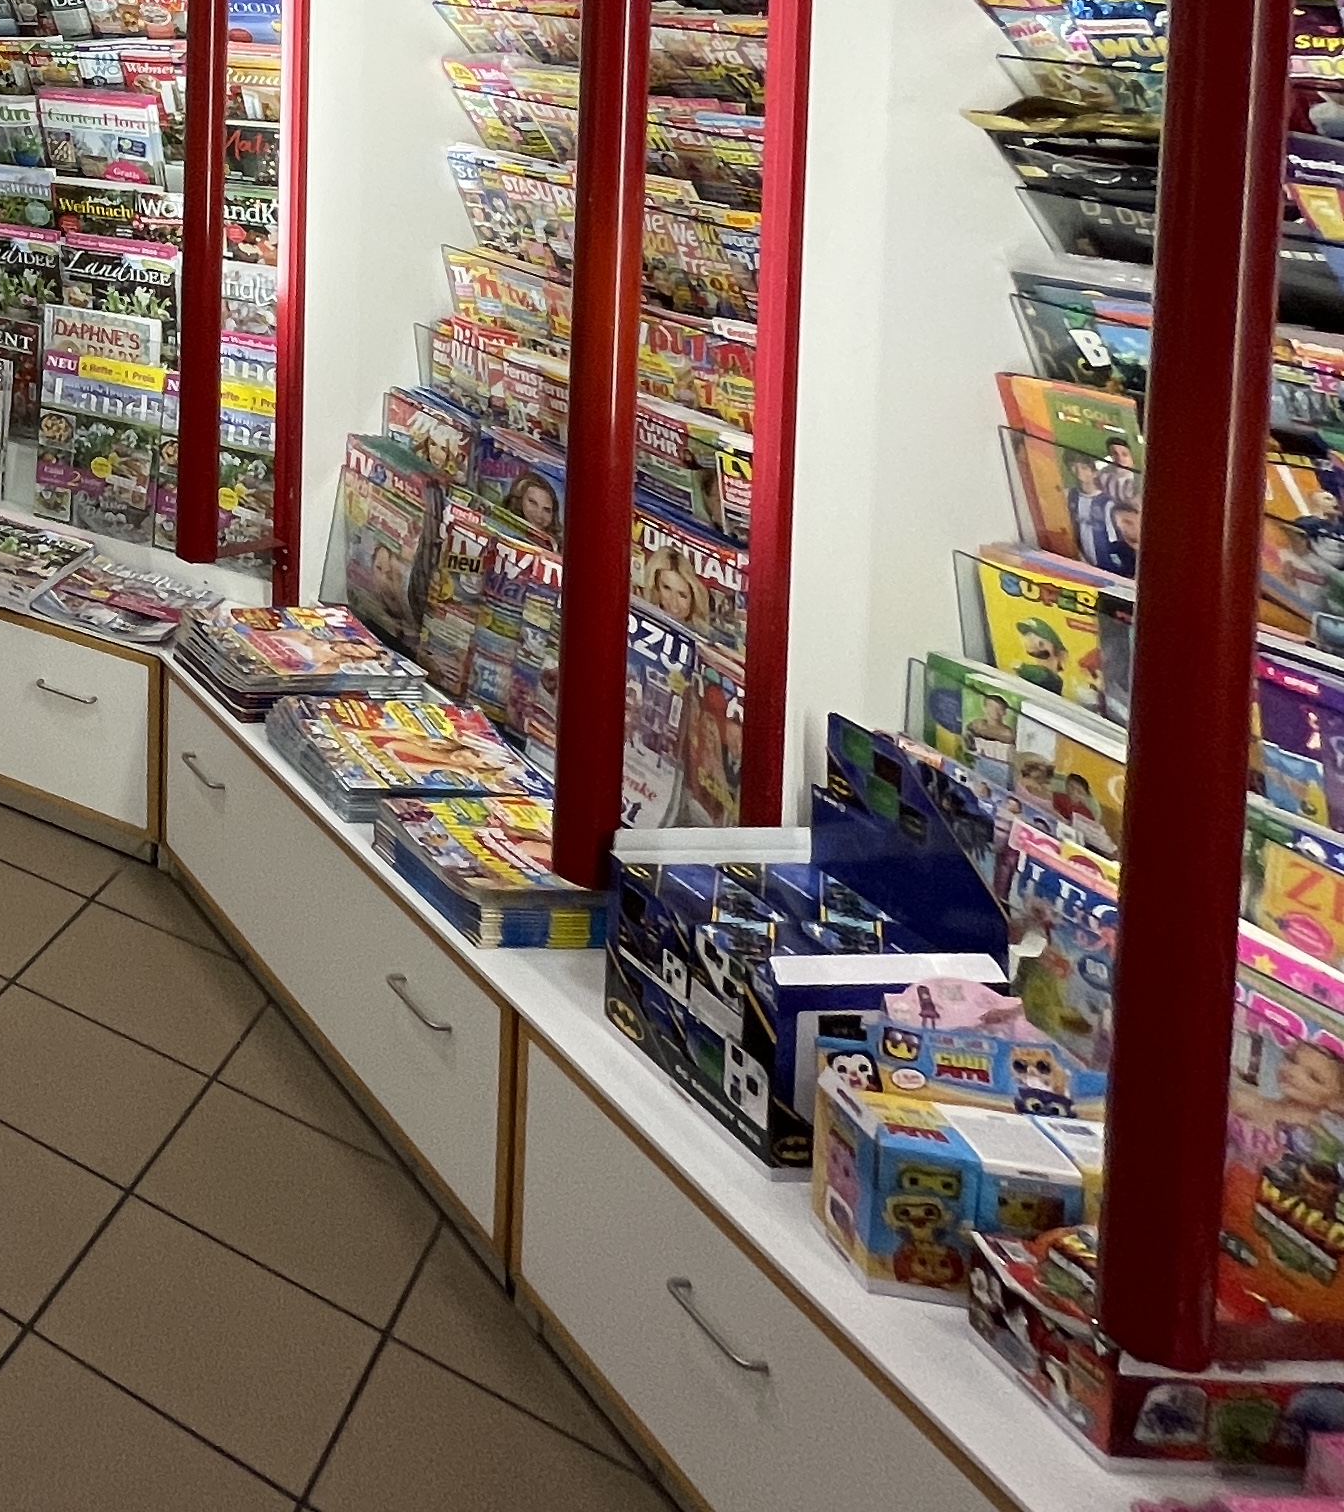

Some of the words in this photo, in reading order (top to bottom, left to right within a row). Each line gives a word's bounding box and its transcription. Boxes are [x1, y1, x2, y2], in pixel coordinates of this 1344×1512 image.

[55, 318, 140, 350] DAPHNE'S
[46, 354, 78, 371] NEU
[447, 553, 481, 573] neu
